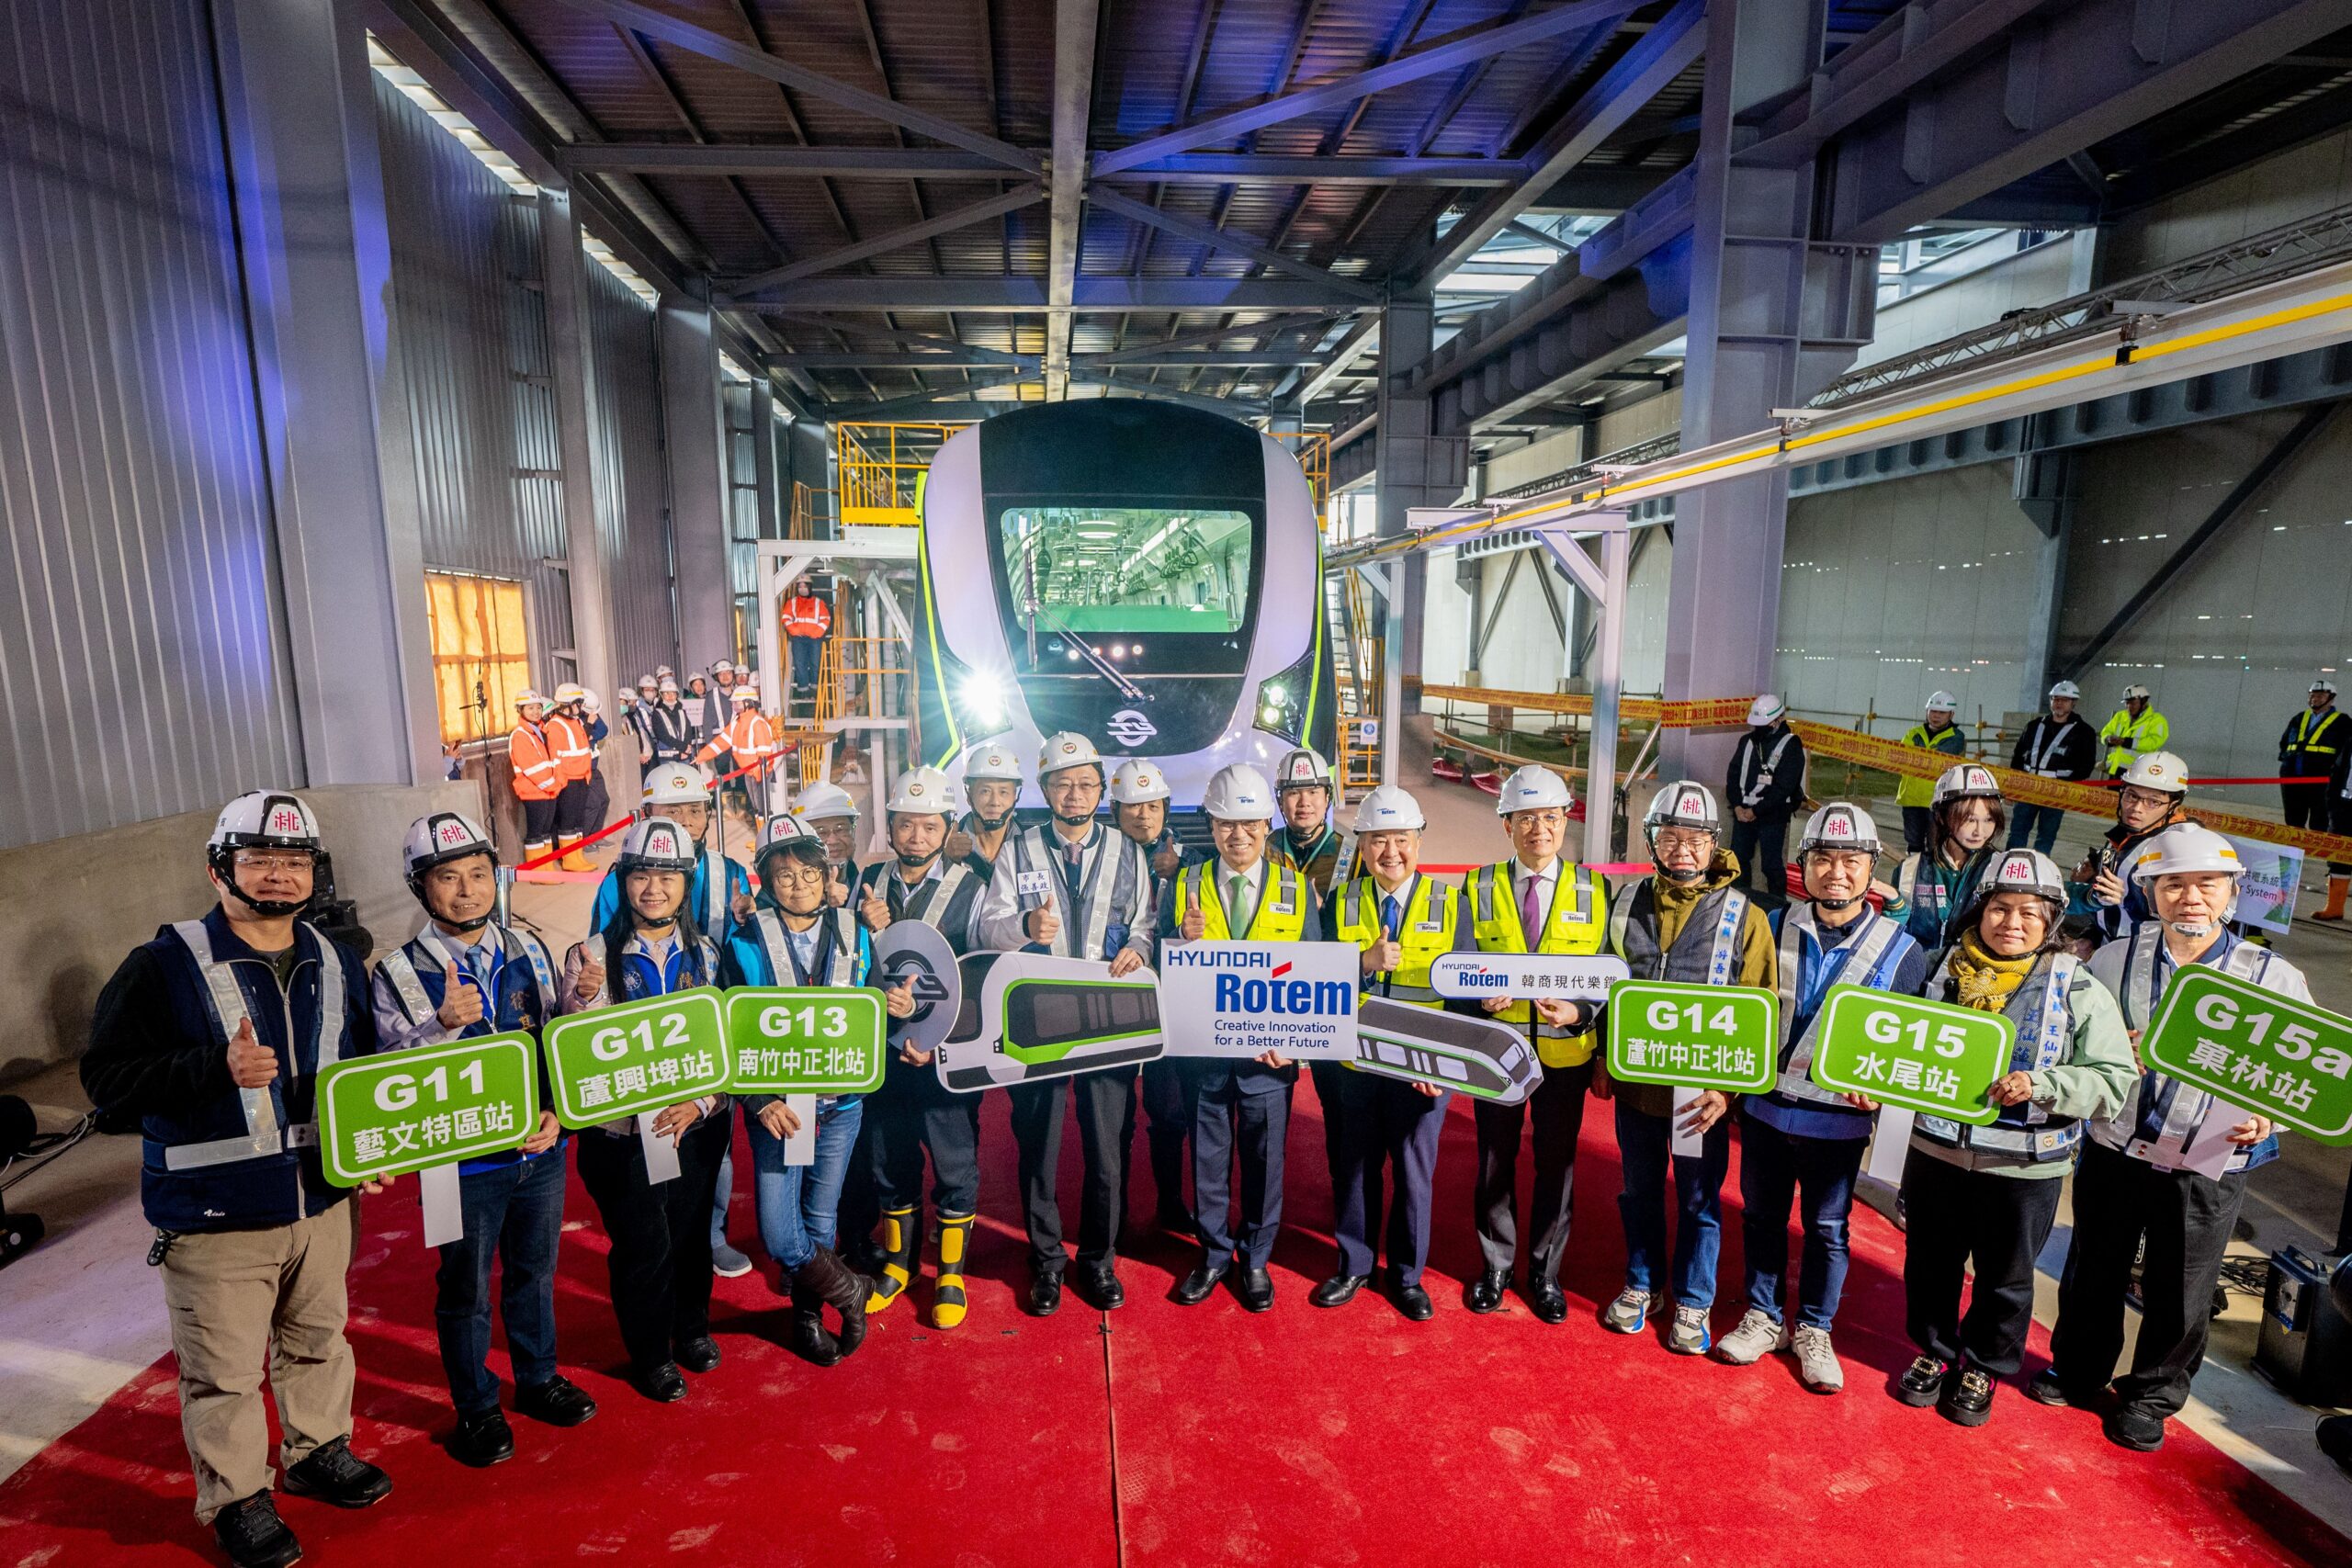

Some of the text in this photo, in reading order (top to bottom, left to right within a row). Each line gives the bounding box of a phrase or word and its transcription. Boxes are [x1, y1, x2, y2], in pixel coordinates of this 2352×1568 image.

[2246, 885, 2278, 901] System
[1168, 950, 1272, 968] HYUNDAI
[1459, 967, 1509, 987] Rotem
[1216, 961, 1351, 1016] Rotem
[591, 1012, 691, 1062] G12
[758, 1006, 848, 1037] G13
[1215, 1020, 1336, 1033] Creative Innovation
[1646, 1000, 1738, 1036] G14
[1864, 1010, 1967, 1058] G15
[2194, 994, 2352, 1080] G15a
[738, 1047, 866, 1077] 南竹中正北站
[1215, 1034, 1329, 1048] for a Better Future
[1626, 1037, 1757, 1077] 蘆竹中正北站
[374, 1059, 484, 1111] G11
[576, 1049, 715, 1109] 蘆興埤站
[1852, 1052, 1962, 1100] 水尾站
[2187, 1036, 2319, 1113] 菓林站
[353, 1100, 514, 1165] 藝文特區站
